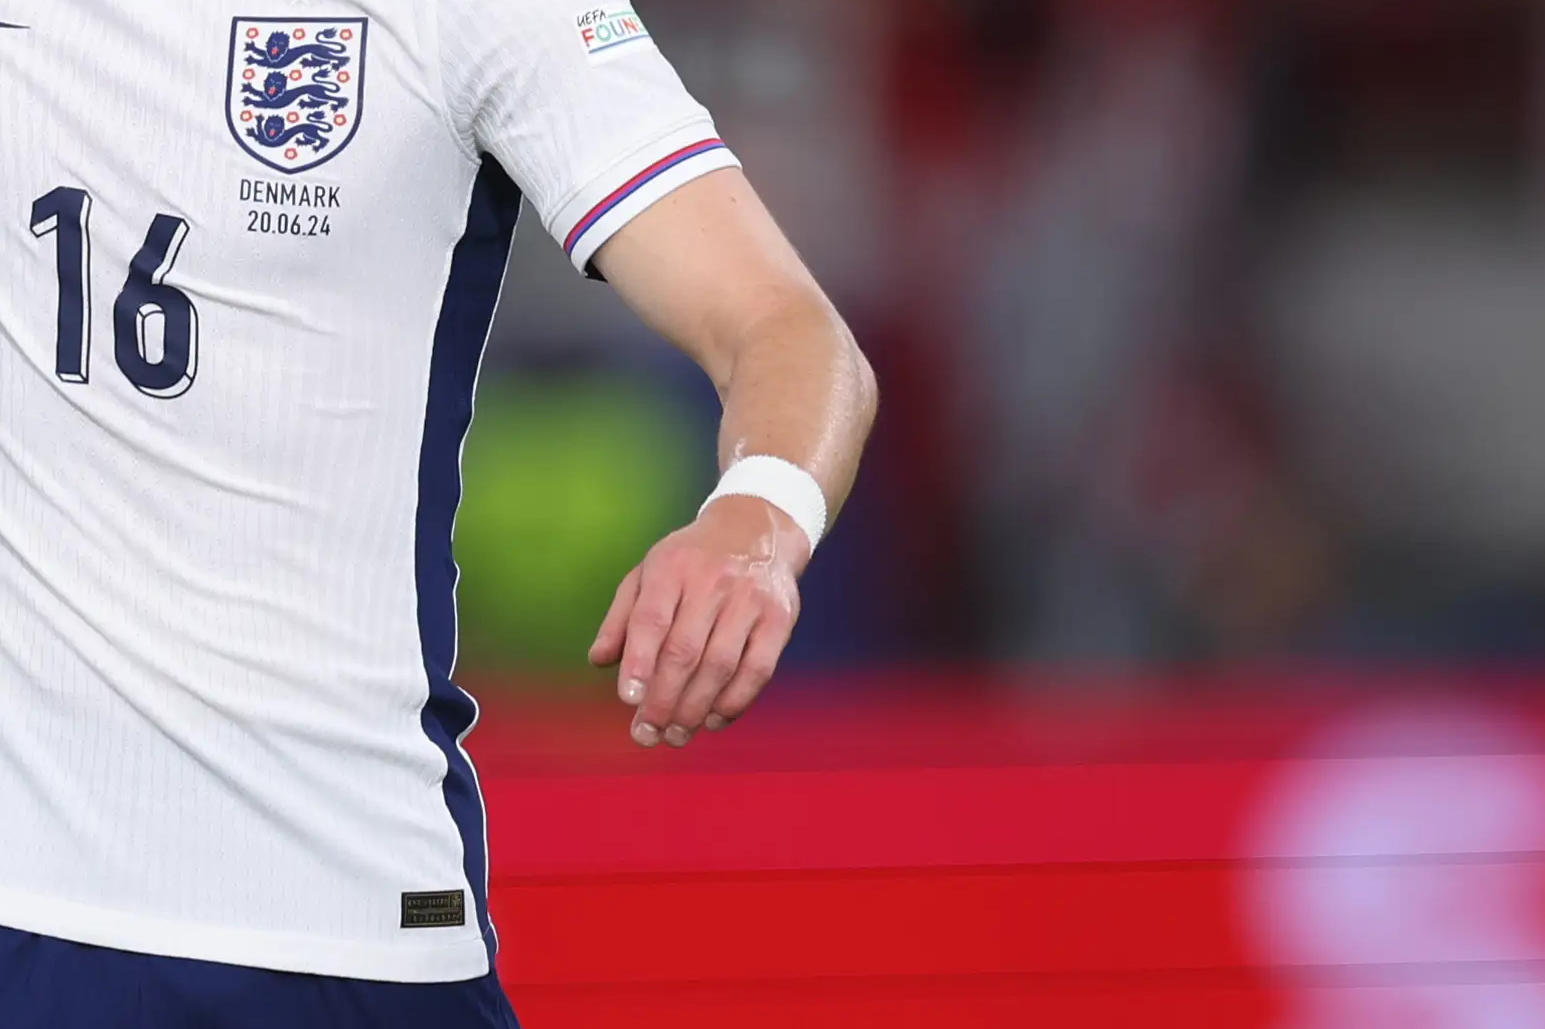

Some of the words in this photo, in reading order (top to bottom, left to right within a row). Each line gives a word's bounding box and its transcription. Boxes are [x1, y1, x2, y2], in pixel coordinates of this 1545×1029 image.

[577, 9, 607, 28] UEFA
[239, 178, 341, 208] DENMARK
[247, 209, 331, 236] 20.06.24
[29, 185, 199, 400] 16
